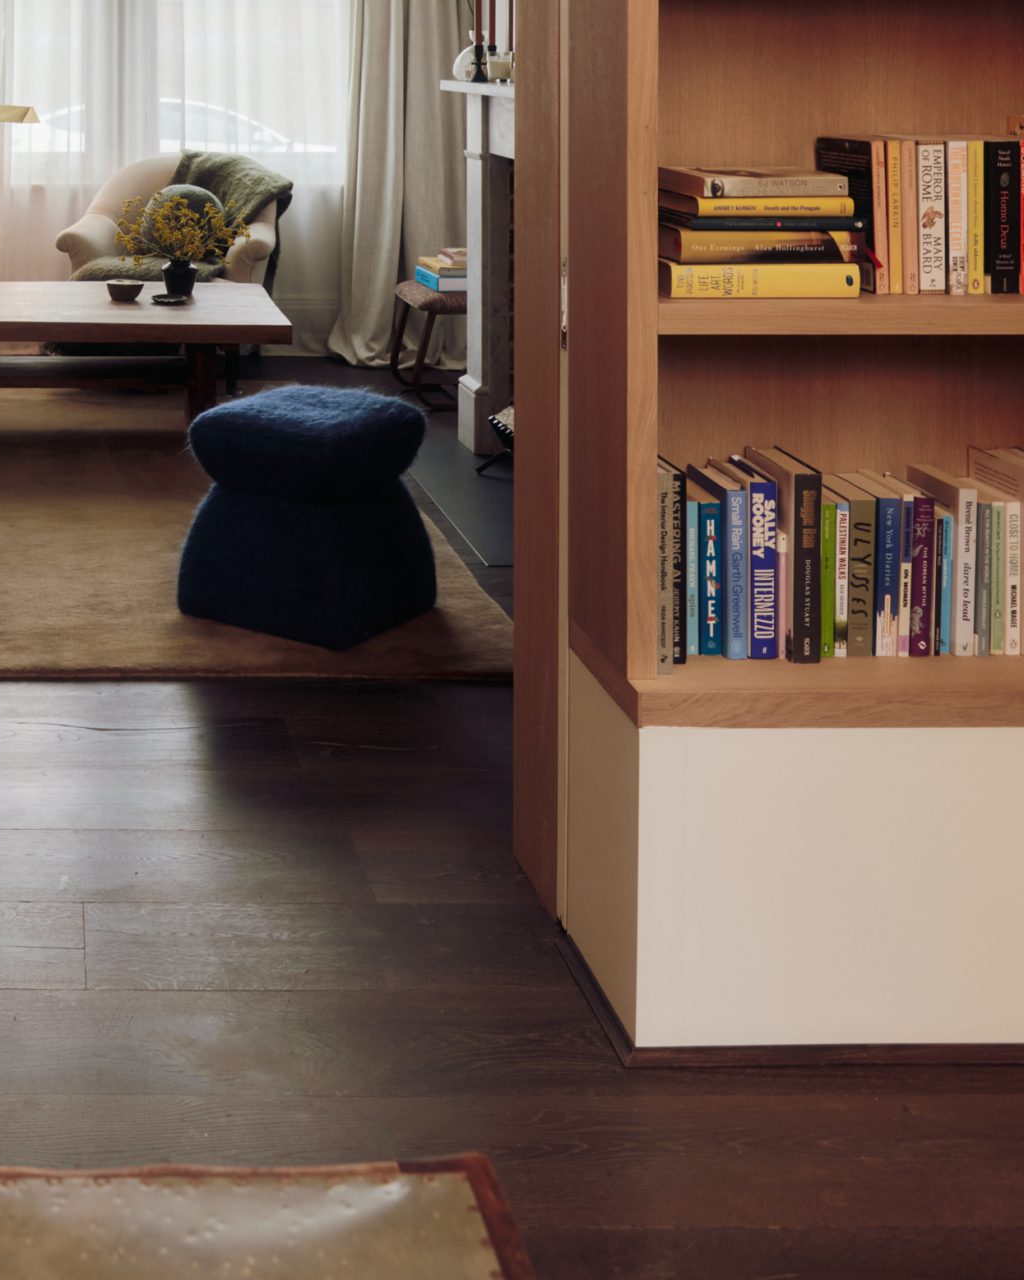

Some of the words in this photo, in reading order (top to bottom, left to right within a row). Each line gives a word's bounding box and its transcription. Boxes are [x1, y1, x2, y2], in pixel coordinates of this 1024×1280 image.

[922, 148, 931, 161] OF
[922, 164, 932, 203] ROME
[933, 148, 943, 201] EMPEROR
[1001, 190, 1009, 222] Homo
[710, 244, 745, 253] Evenings
[776, 244, 825, 253] Hollinghurst
[1000, 224, 1008, 249] Deus
[922, 232, 932, 274] BEARD
[933, 236, 943, 271] MARY
[731, 496, 743, 526] Small
[764, 499, 775, 550] SALLY
[965, 500, 973, 525] Brené
[731, 528, 743, 550] Rain
[752, 492, 764, 559] ROONEY
[838, 513, 847, 556] PALESTINIAN
[1008, 514, 1019, 539] CLOSE
[658, 531, 667, 554] Design
[964, 526, 972, 553] Brown
[1009, 541, 1019, 551] TO
[706, 519, 716, 638] HAMNET
[731, 551, 743, 583] Garth
[838, 557, 846, 580] WALKS
[850, 522, 872, 618] ULYSSES
[885, 552, 893, 587] Diaries
[903, 569, 908, 580] ON
[963, 562, 972, 587] dare
[1009, 553, 1019, 578] HOME
[754, 568, 775, 639] INTERMEZZO
[963, 588, 970, 598] to
[731, 584, 743, 638] Greenwell
[962, 600, 971, 622] lead
